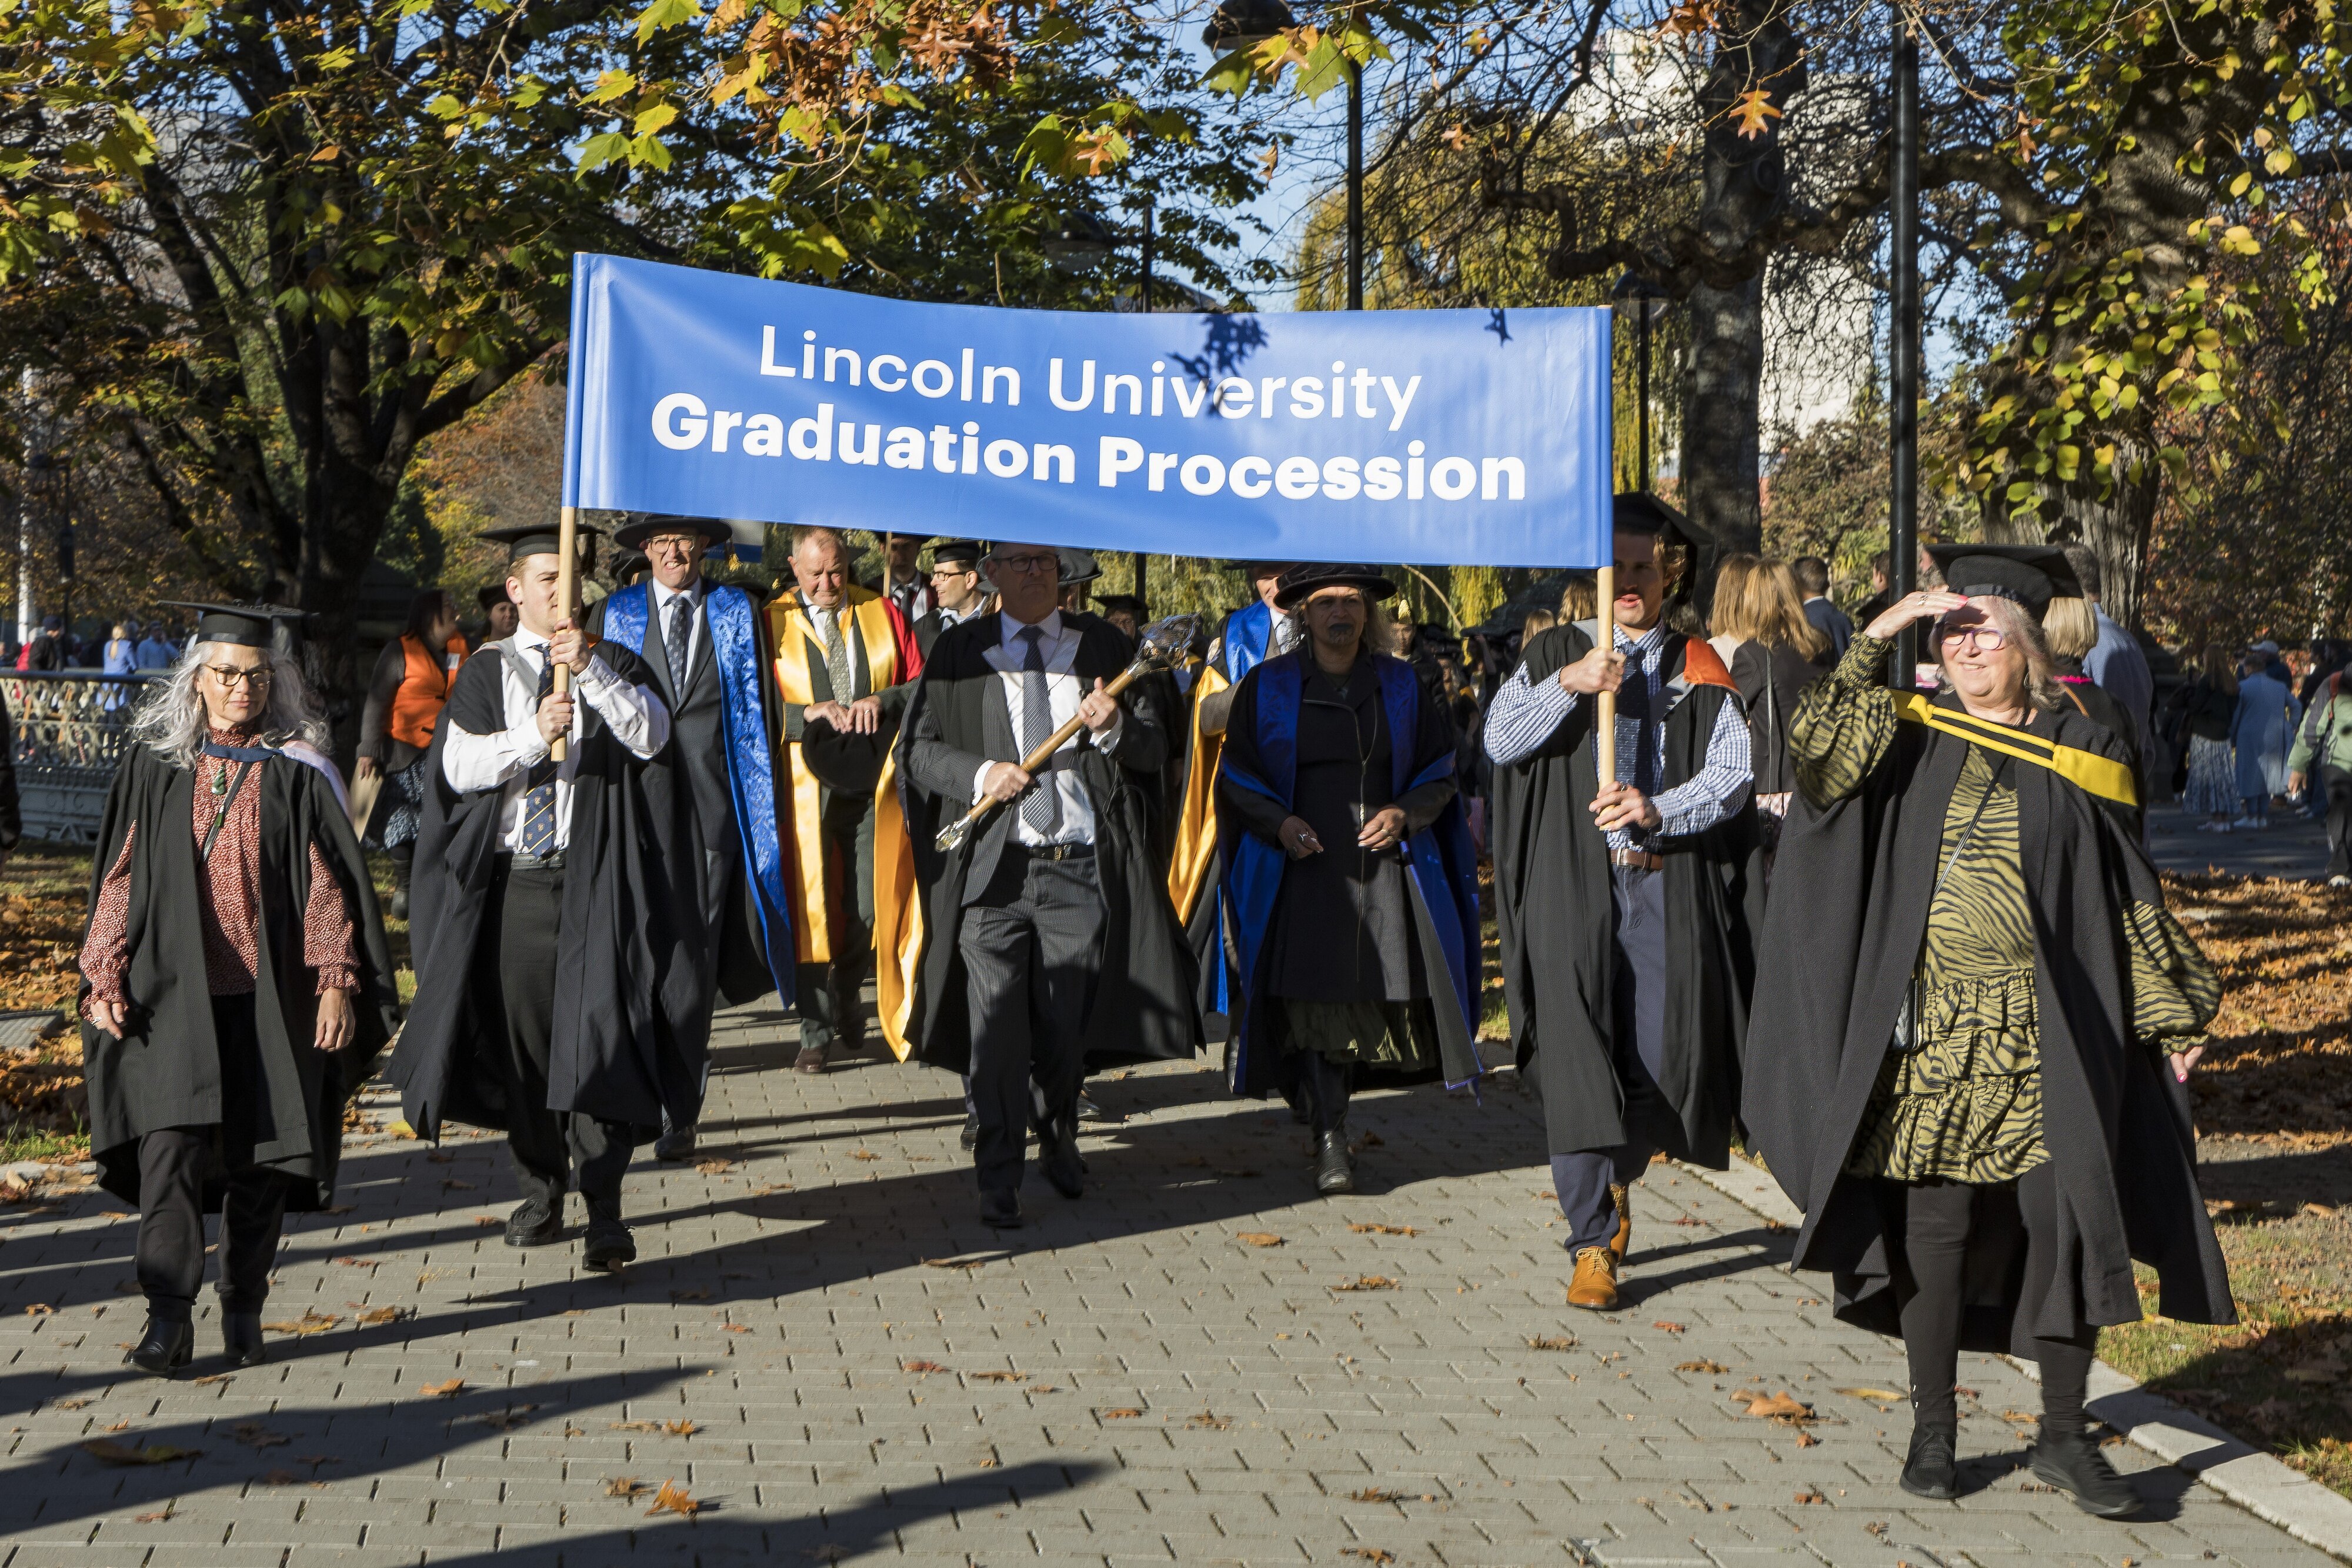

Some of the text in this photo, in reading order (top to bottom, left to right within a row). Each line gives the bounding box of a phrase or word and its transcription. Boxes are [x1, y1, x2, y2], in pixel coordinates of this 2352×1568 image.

[760, 325, 1423, 432] Lincoln University
[651, 392, 1526, 501] Graduation Procession
